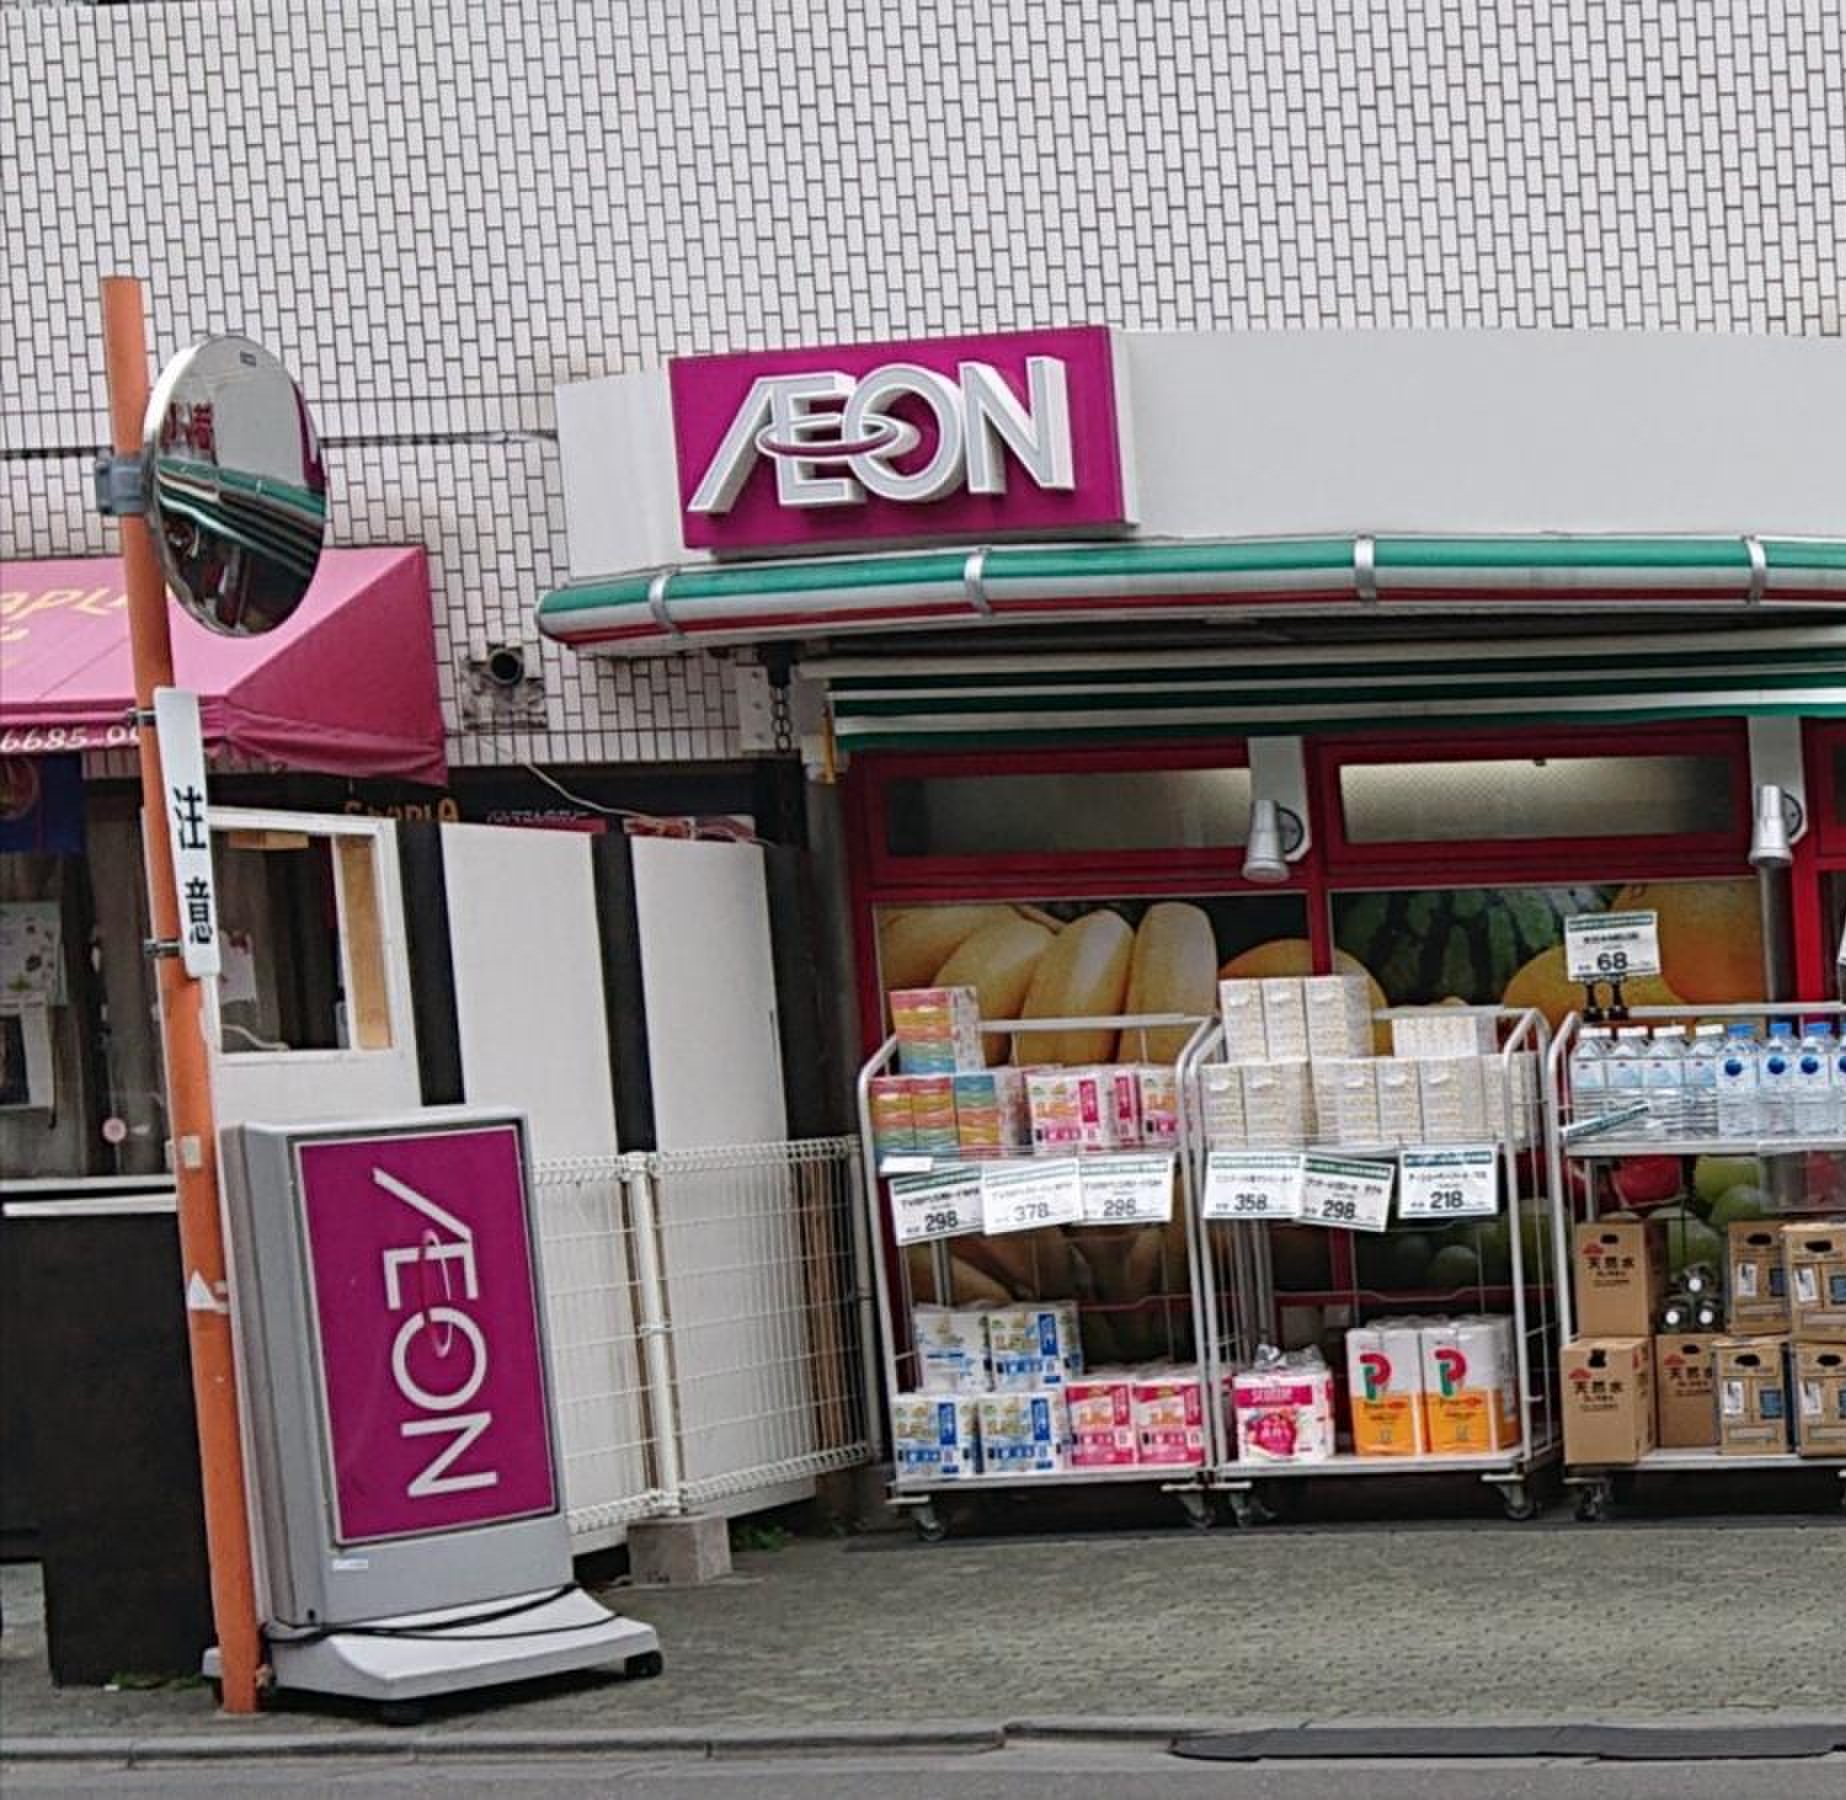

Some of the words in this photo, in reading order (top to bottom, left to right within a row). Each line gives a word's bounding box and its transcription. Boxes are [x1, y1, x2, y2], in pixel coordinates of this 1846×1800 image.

[174, 786, 213, 945] 注意
[1597, 951, 1628, 971] 68
[1235, 1193, 1269, 1212] 358
[1430, 1190, 1464, 1210] 218
[1014, 1202, 1050, 1222] 378
[1322, 1200, 1356, 1221] 298
[924, 1210, 959, 1233] 298
